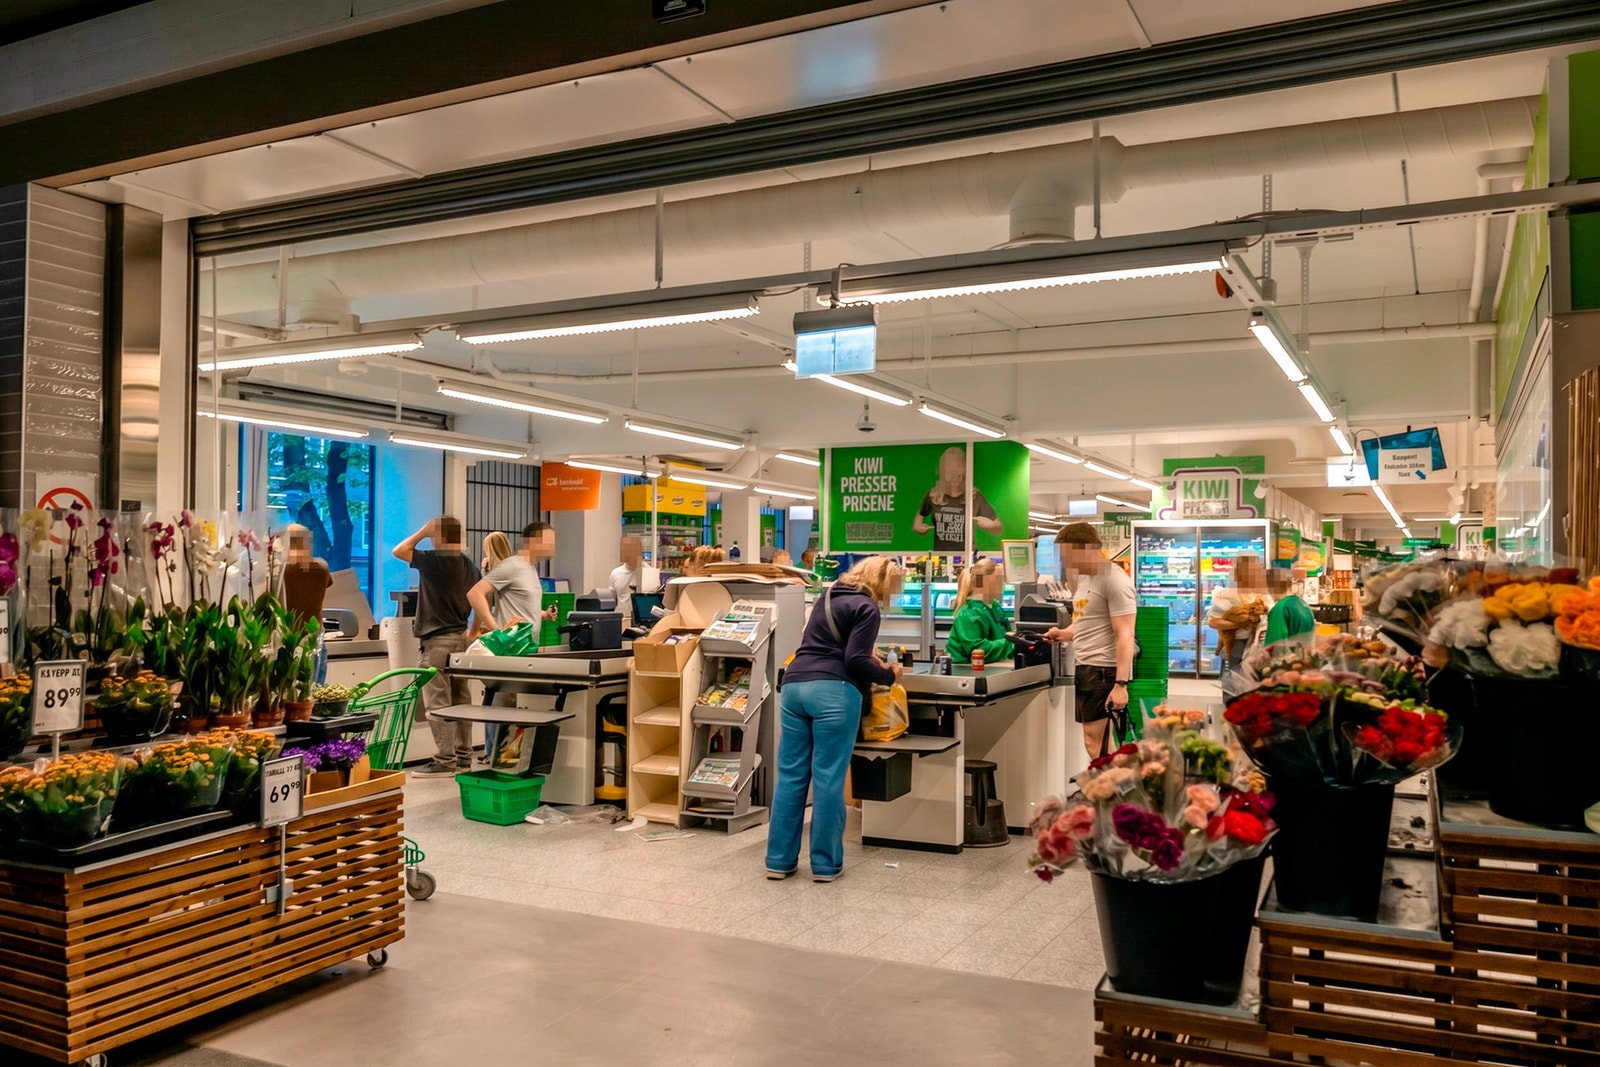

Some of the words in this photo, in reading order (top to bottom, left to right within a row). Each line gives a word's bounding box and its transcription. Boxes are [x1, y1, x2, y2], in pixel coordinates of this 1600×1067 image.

[854, 457, 883, 474] KIWI
[841, 475, 897, 493] PRESSER
[1183, 479, 1229, 499] KIWI
[843, 495, 895, 512] PRISENE
